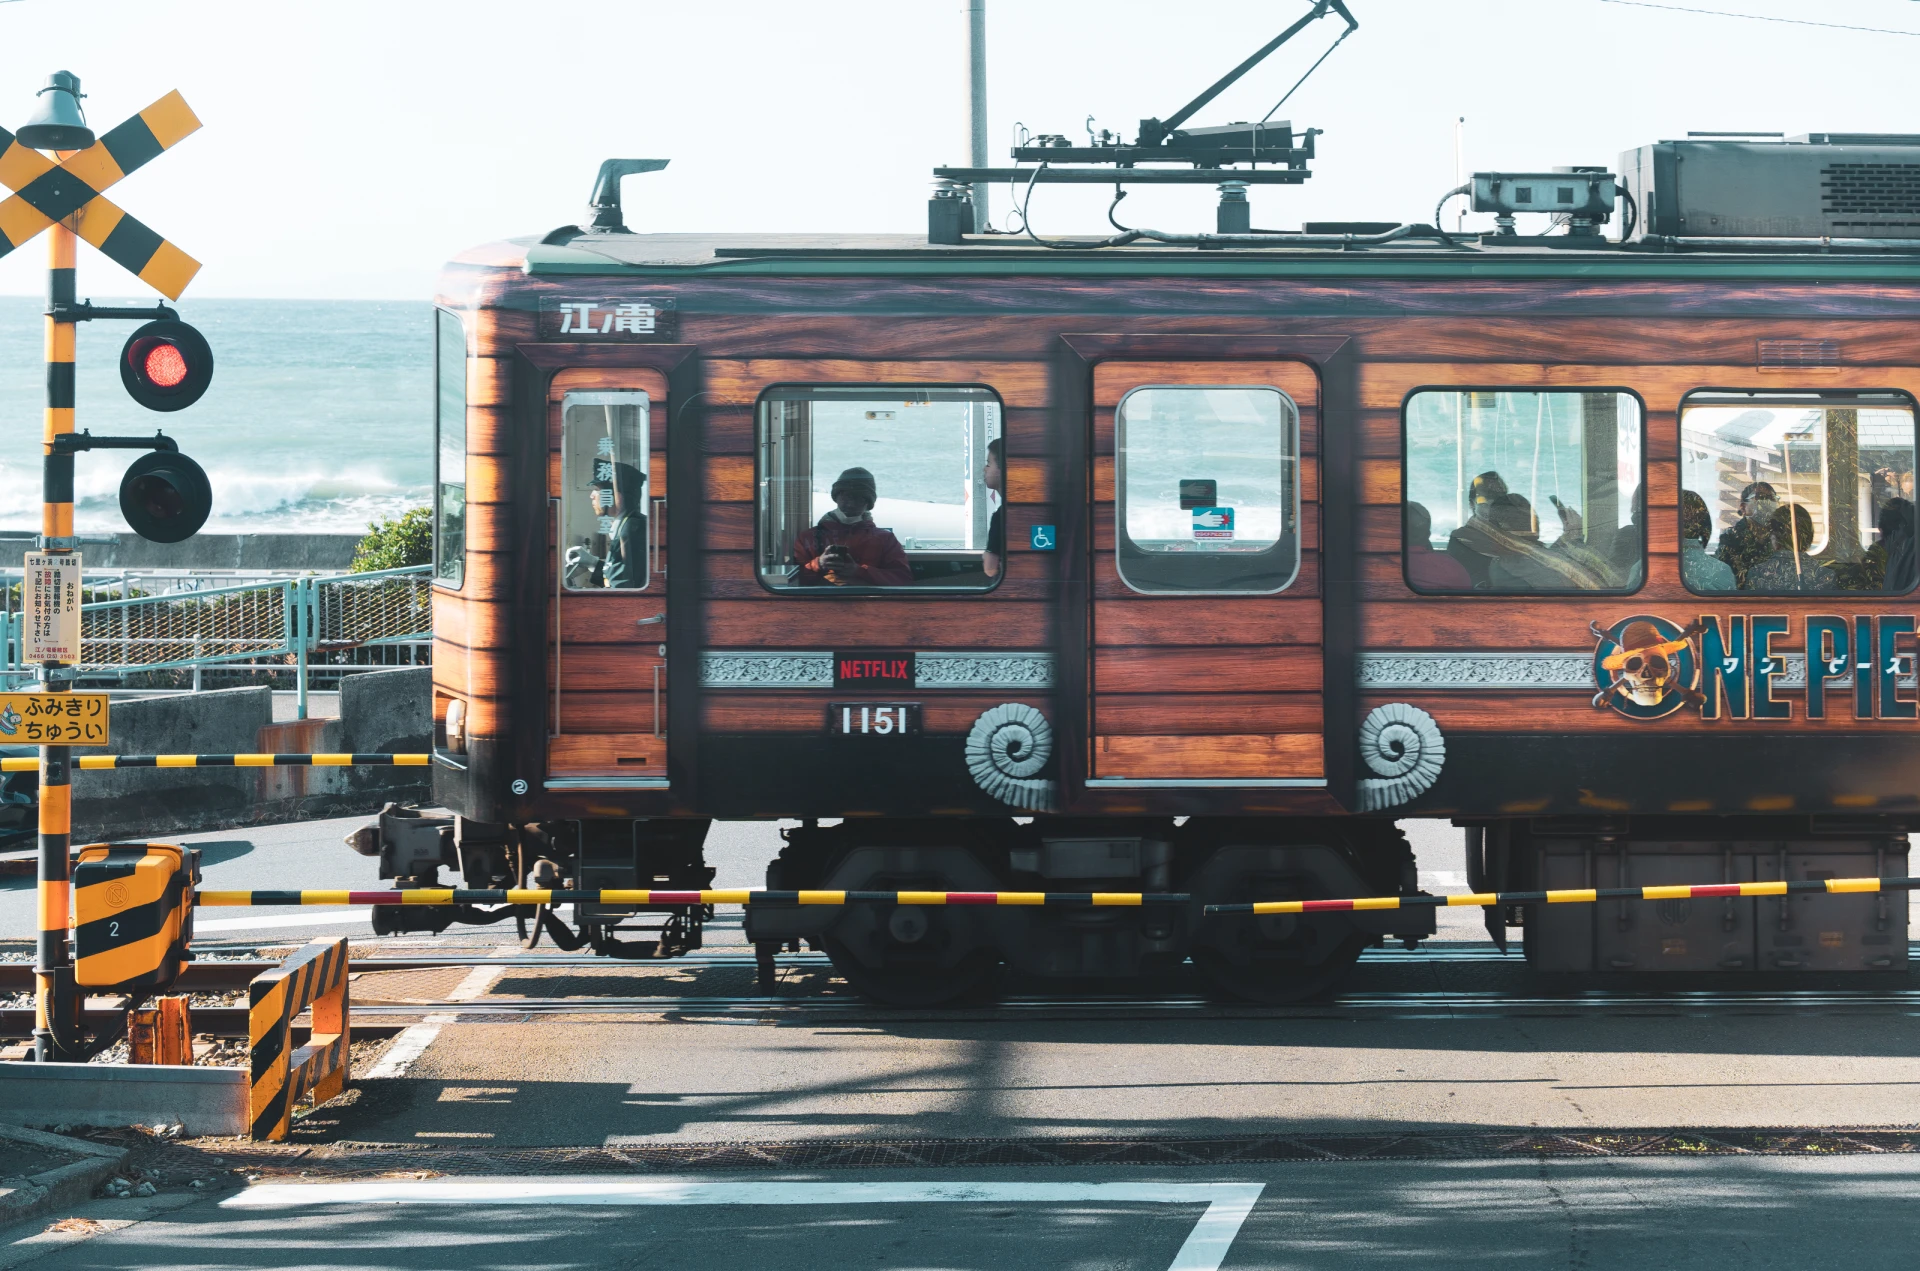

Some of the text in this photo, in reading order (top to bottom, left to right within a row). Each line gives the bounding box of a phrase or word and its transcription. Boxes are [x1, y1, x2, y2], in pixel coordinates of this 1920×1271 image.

[596, 437, 616, 534] 乗務員室
[34, 571, 42, 643] 下記にお知らせ下さい
[43, 571, 51, 637] 故障にお気付の方は
[66, 582, 74, 612] おねがい
[840, 660, 908, 680] NETFLIX
[1723, 655, 1902, 674] ワンピース
[25, 697, 102, 717] ふみきり
[25, 721, 103, 741] ちゅうい
[842, 707, 906, 734] 1151
[109, 921, 119, 937] 2
